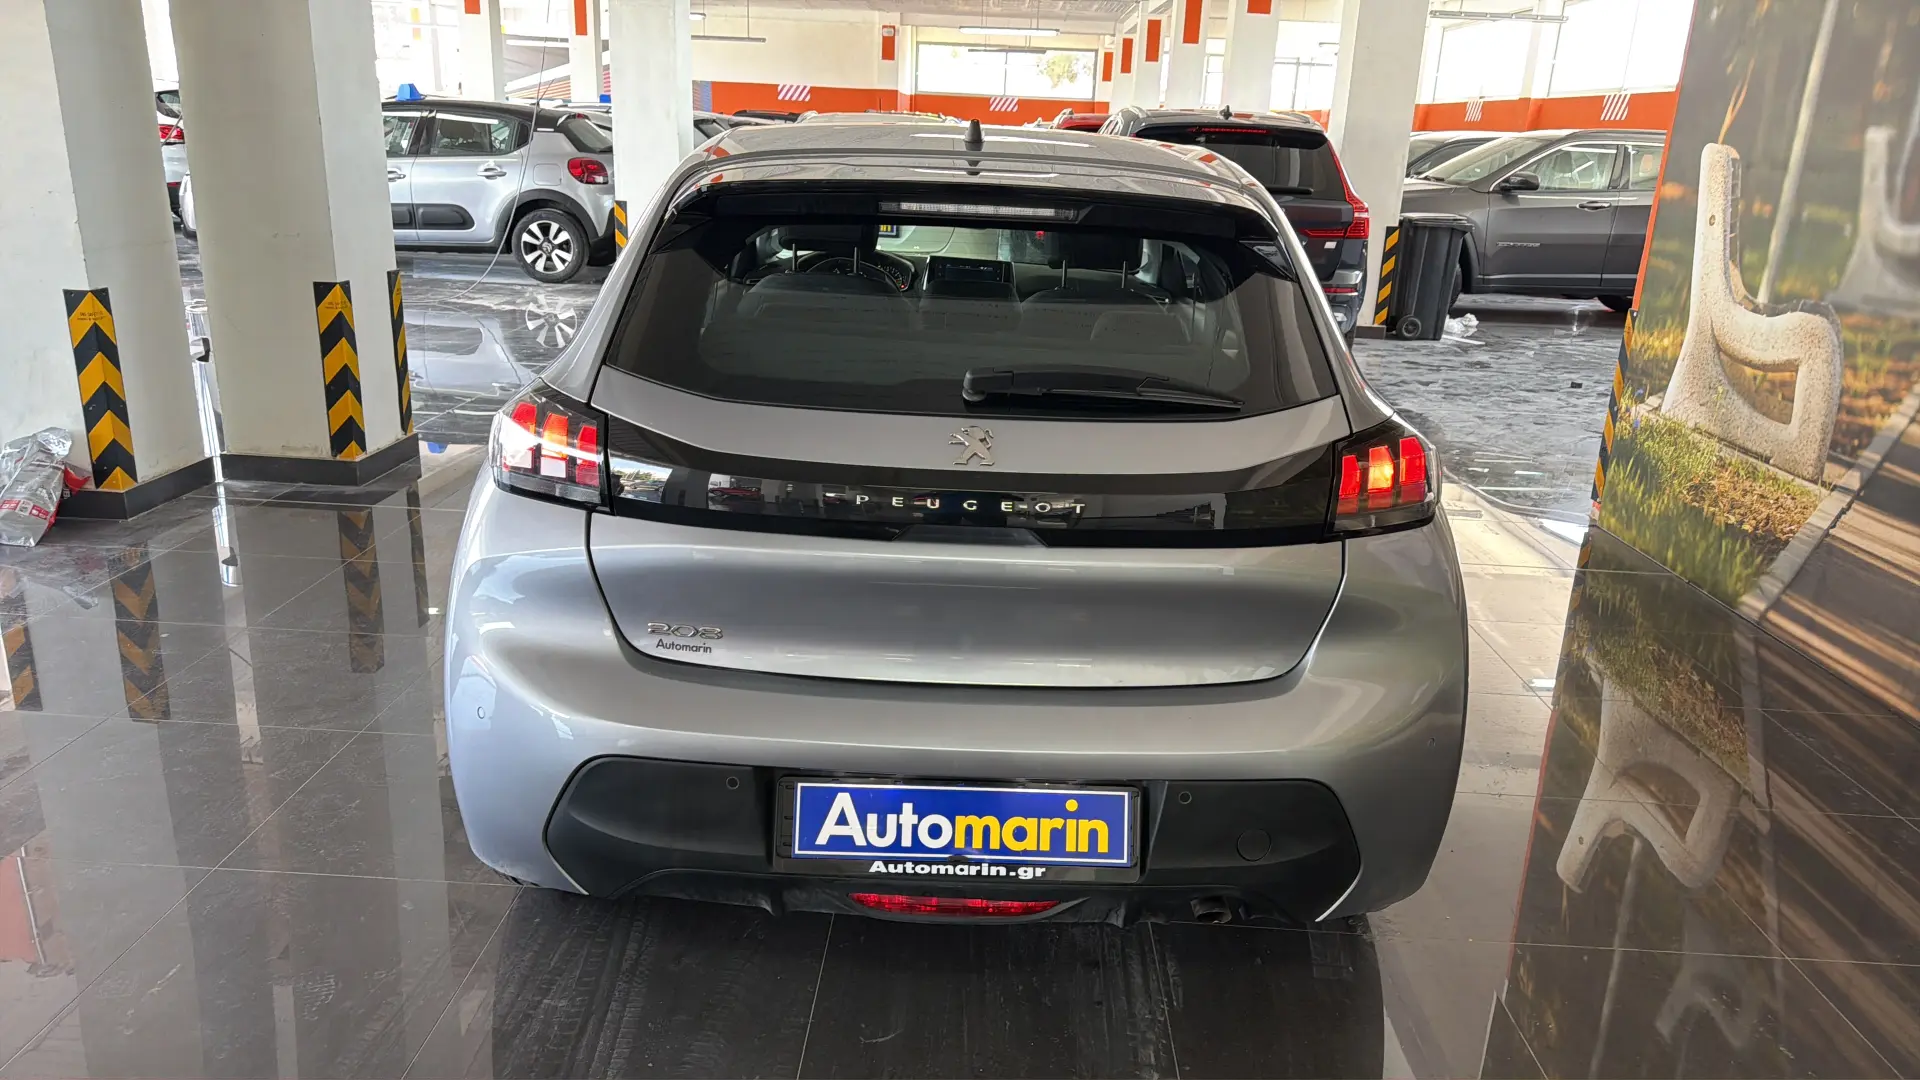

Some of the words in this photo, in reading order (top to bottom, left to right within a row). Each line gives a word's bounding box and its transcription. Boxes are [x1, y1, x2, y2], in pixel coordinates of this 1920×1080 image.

[855, 494, 1086, 515] PEUGEOT
[647, 622, 723, 639] 208
[655, 639, 712, 653] Automarin
[814, 791, 1109, 853] Automarin
[868, 860, 1046, 880] Automarin.gr
